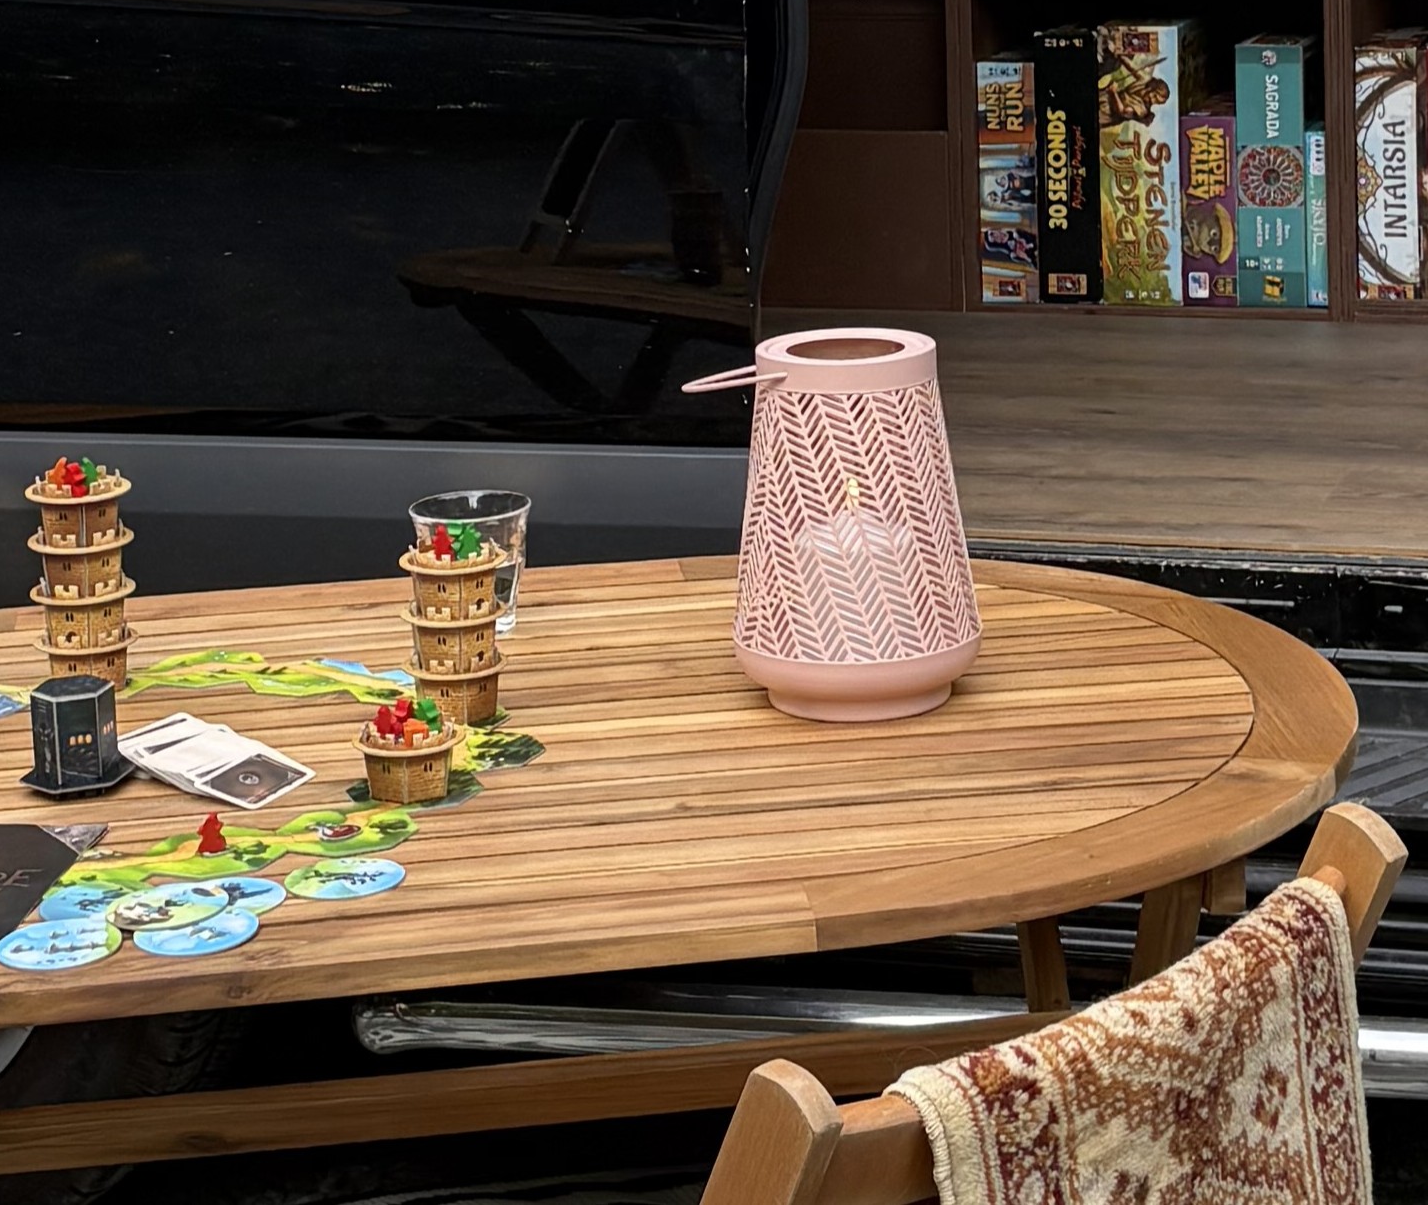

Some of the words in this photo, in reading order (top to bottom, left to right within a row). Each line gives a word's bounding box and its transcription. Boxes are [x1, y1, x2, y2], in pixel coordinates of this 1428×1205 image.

[986, 82, 1001, 130] NUNS
[1006, 81, 1025, 132] RUN
[1265, 74, 1280, 140] SAGRADA
[1046, 108, 1067, 202] SECONDS
[1186, 124, 1211, 203] VALLEY
[1206, 126, 1228, 198] MAPLE
[1382, 119, 1408, 240] INTARSIA
[1048, 203, 1068, 230] 30
[1102, 130, 1143, 283] TIJDPERK
[1143, 138, 1172, 272] STENEN
